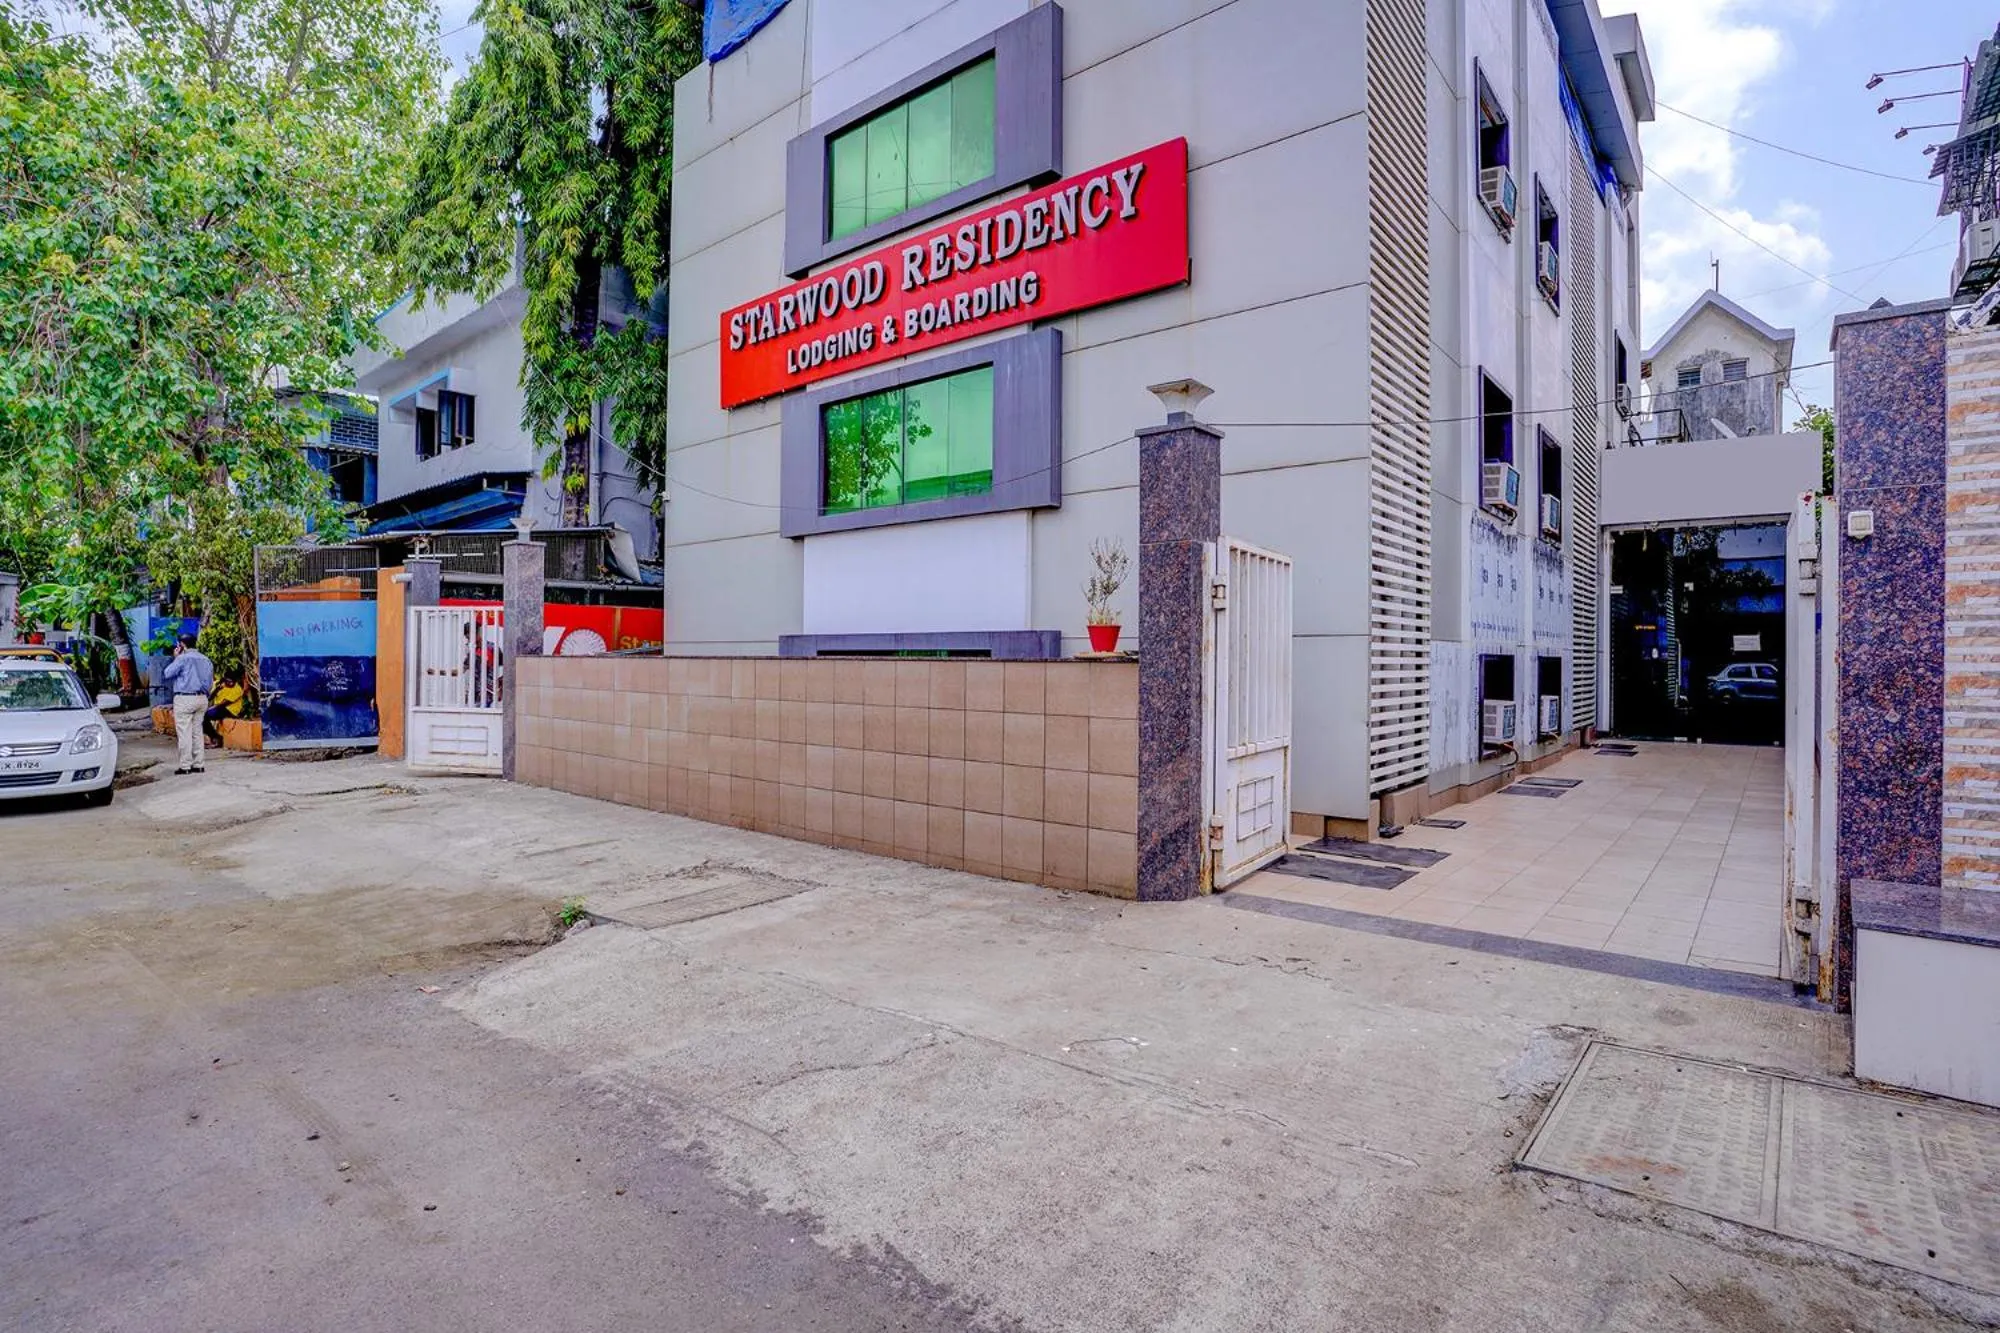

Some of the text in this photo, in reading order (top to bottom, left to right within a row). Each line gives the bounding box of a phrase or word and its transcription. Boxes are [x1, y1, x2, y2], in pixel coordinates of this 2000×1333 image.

[730, 162, 1144, 350] STARWOOD RESIDENCY
[787, 271, 1037, 374] LODGING & BOARDING
